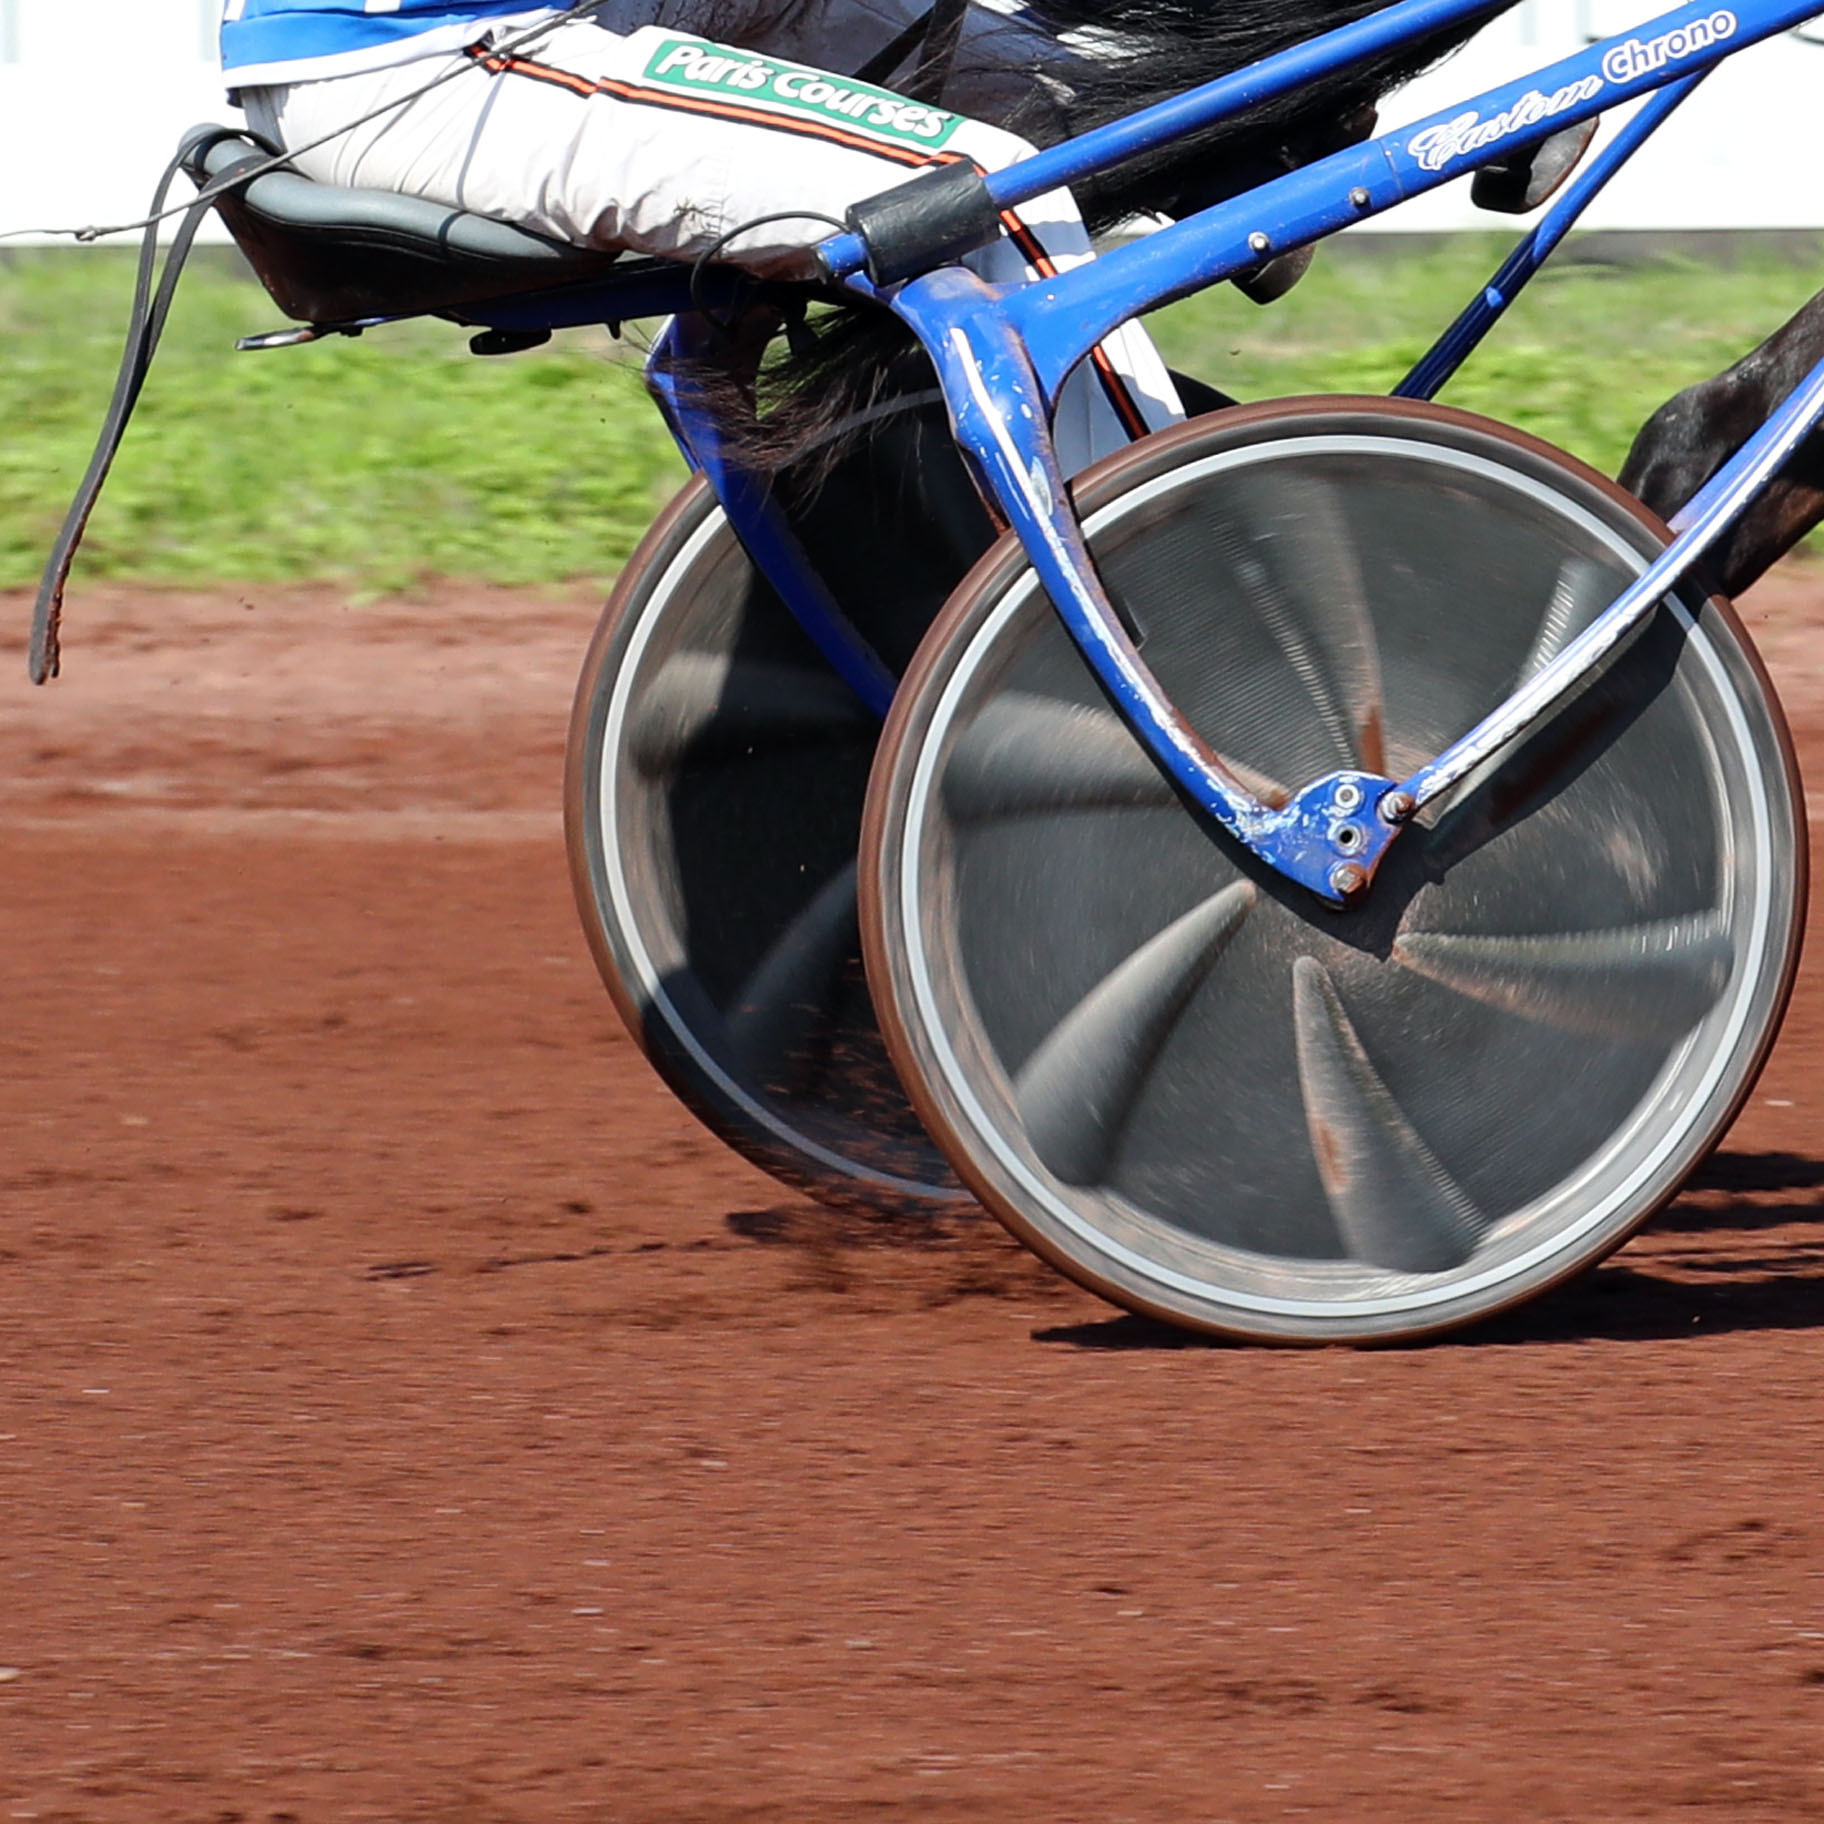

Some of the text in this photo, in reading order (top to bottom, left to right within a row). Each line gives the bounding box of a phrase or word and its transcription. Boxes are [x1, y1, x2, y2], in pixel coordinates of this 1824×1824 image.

[655, 45, 952, 138] Paris Courses
[1408, 74, 1604, 170] Custom
[1602, 10, 1738, 84] Chrono
